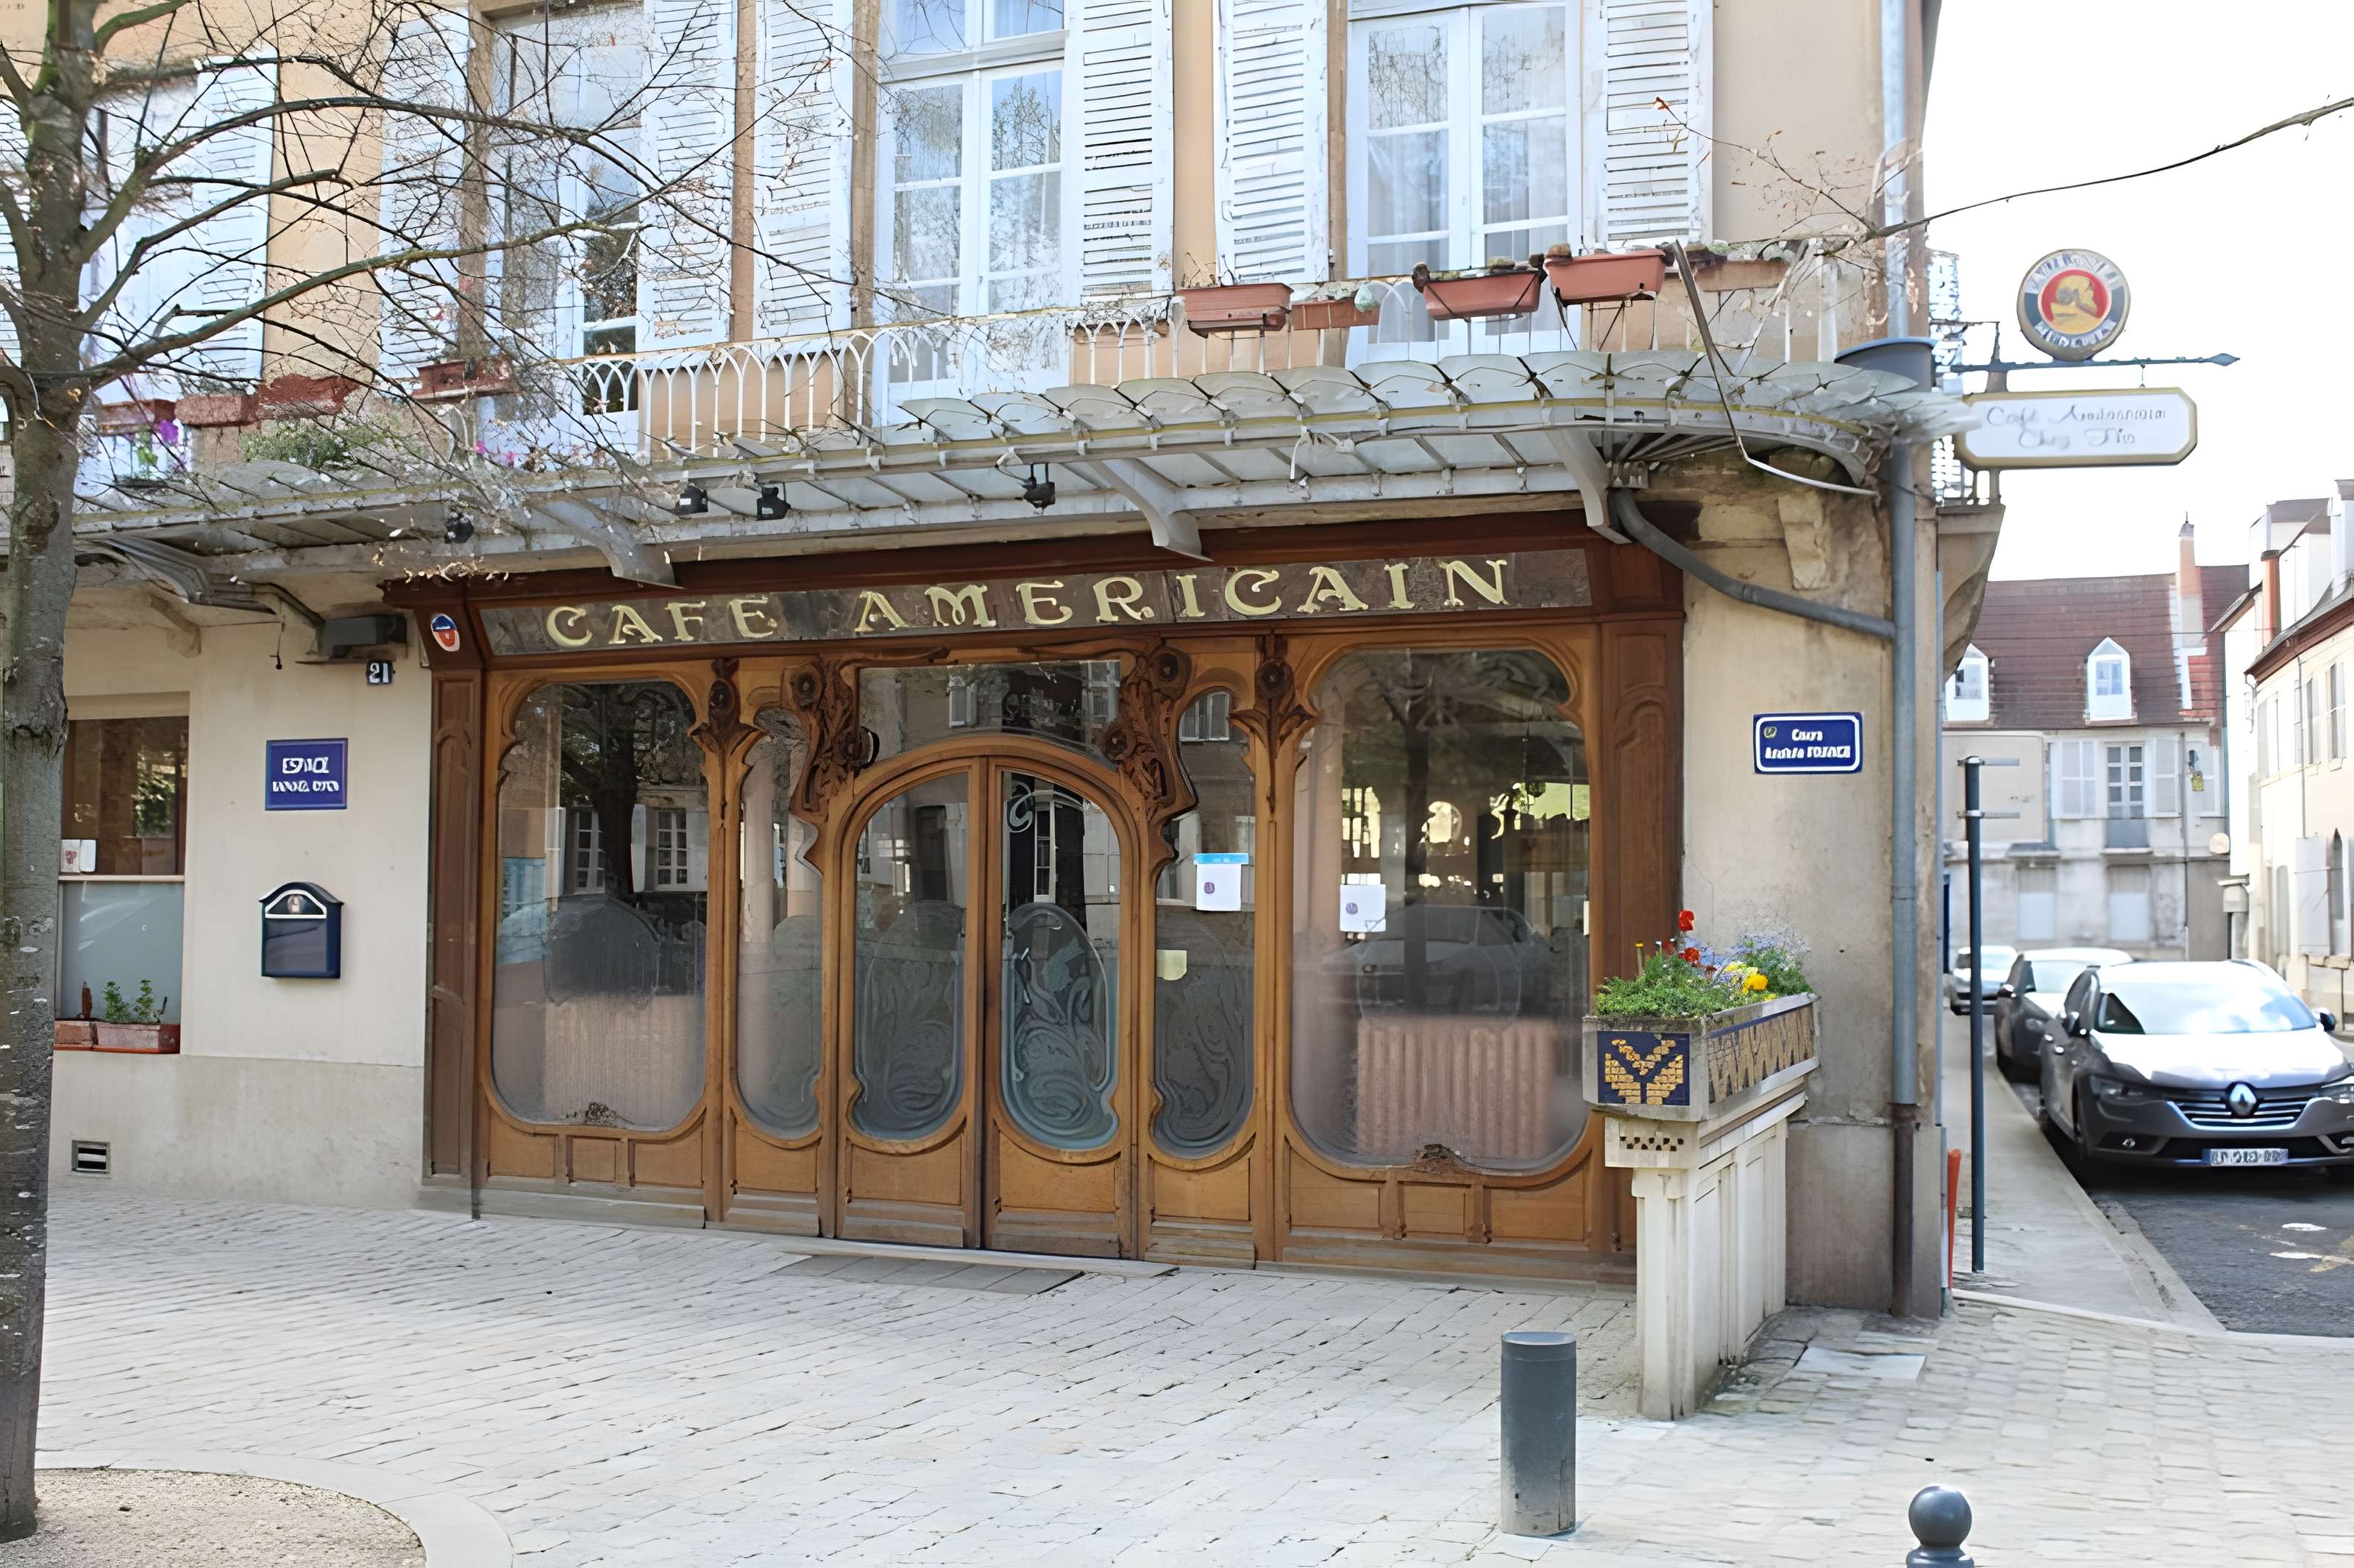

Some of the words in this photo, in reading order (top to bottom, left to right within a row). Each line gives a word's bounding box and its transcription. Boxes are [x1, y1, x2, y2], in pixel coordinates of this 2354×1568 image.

[546, 595, 777, 647] CAFE
[854, 559, 1509, 632] AMERICAIN
[369, 663, 389, 683] 21
